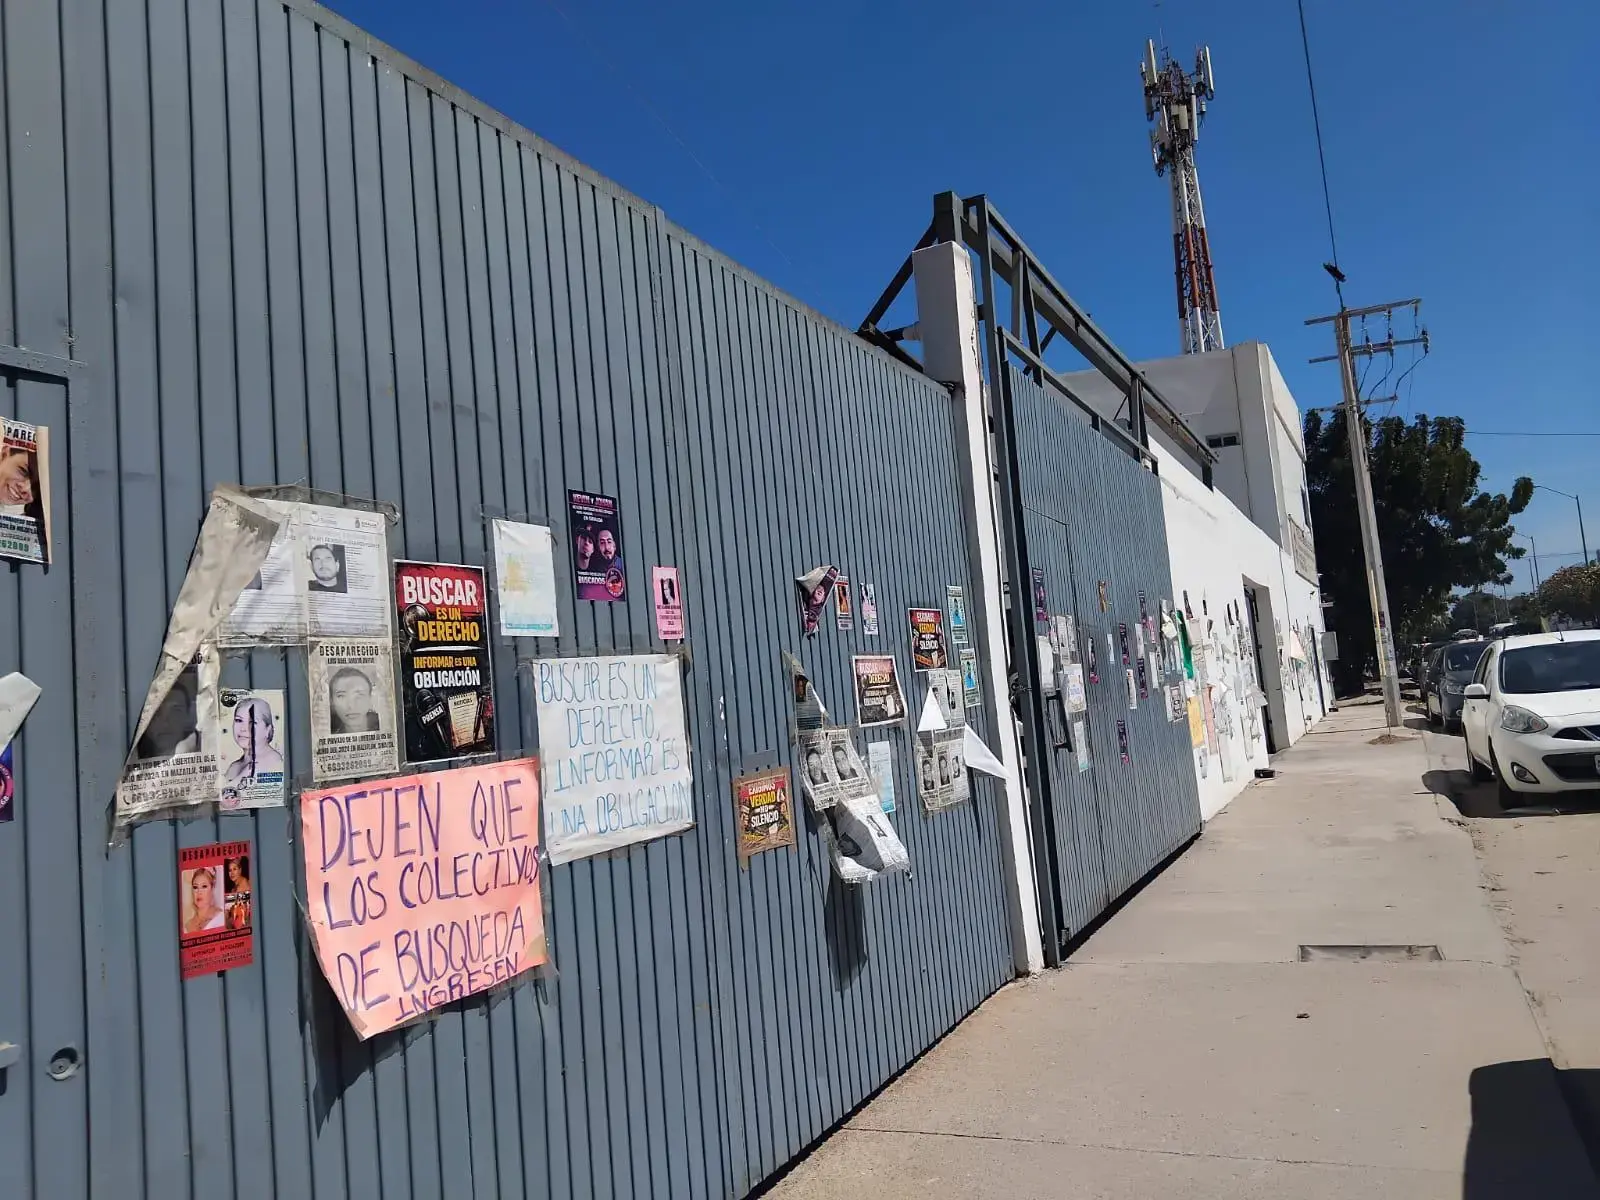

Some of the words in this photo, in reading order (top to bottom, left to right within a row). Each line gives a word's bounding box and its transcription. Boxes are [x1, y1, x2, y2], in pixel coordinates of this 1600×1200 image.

[403, 576, 478, 606] BUSCAR
[436, 607, 448, 620] ES
[449, 608, 461, 621] UN
[417, 621, 480, 642] DERECHO
[320, 646, 379, 656] DESAPARECIDO
[919, 640, 939, 650] SILENCIO
[413, 656, 454, 669] INFORMAR
[413, 667, 480, 689] OBLIGACIÓN
[540, 662, 605, 703] BUSCAR
[609, 662, 628, 701] ES
[633, 663, 657, 700] UN
[421, 705, 444, 725] PRENSA
[567, 703, 661, 748] DERECHO,
[554, 741, 658, 792] INFORMAR
[663, 738, 680, 770] ES
[596, 777, 693, 834] OBLIGACION
[749, 791, 776, 807] VERDAD
[319, 782, 441, 872] DEJEN
[471, 779, 527, 847] QUE
[751, 809, 779, 828] SILENCIO
[323, 871, 387, 930] LOS
[399, 845, 539, 908] COLECTIVOS
[337, 941, 390, 1012] DE
[395, 906, 525, 992] BUSQUEDA
[395, 952, 519, 1021] INGRESEN
